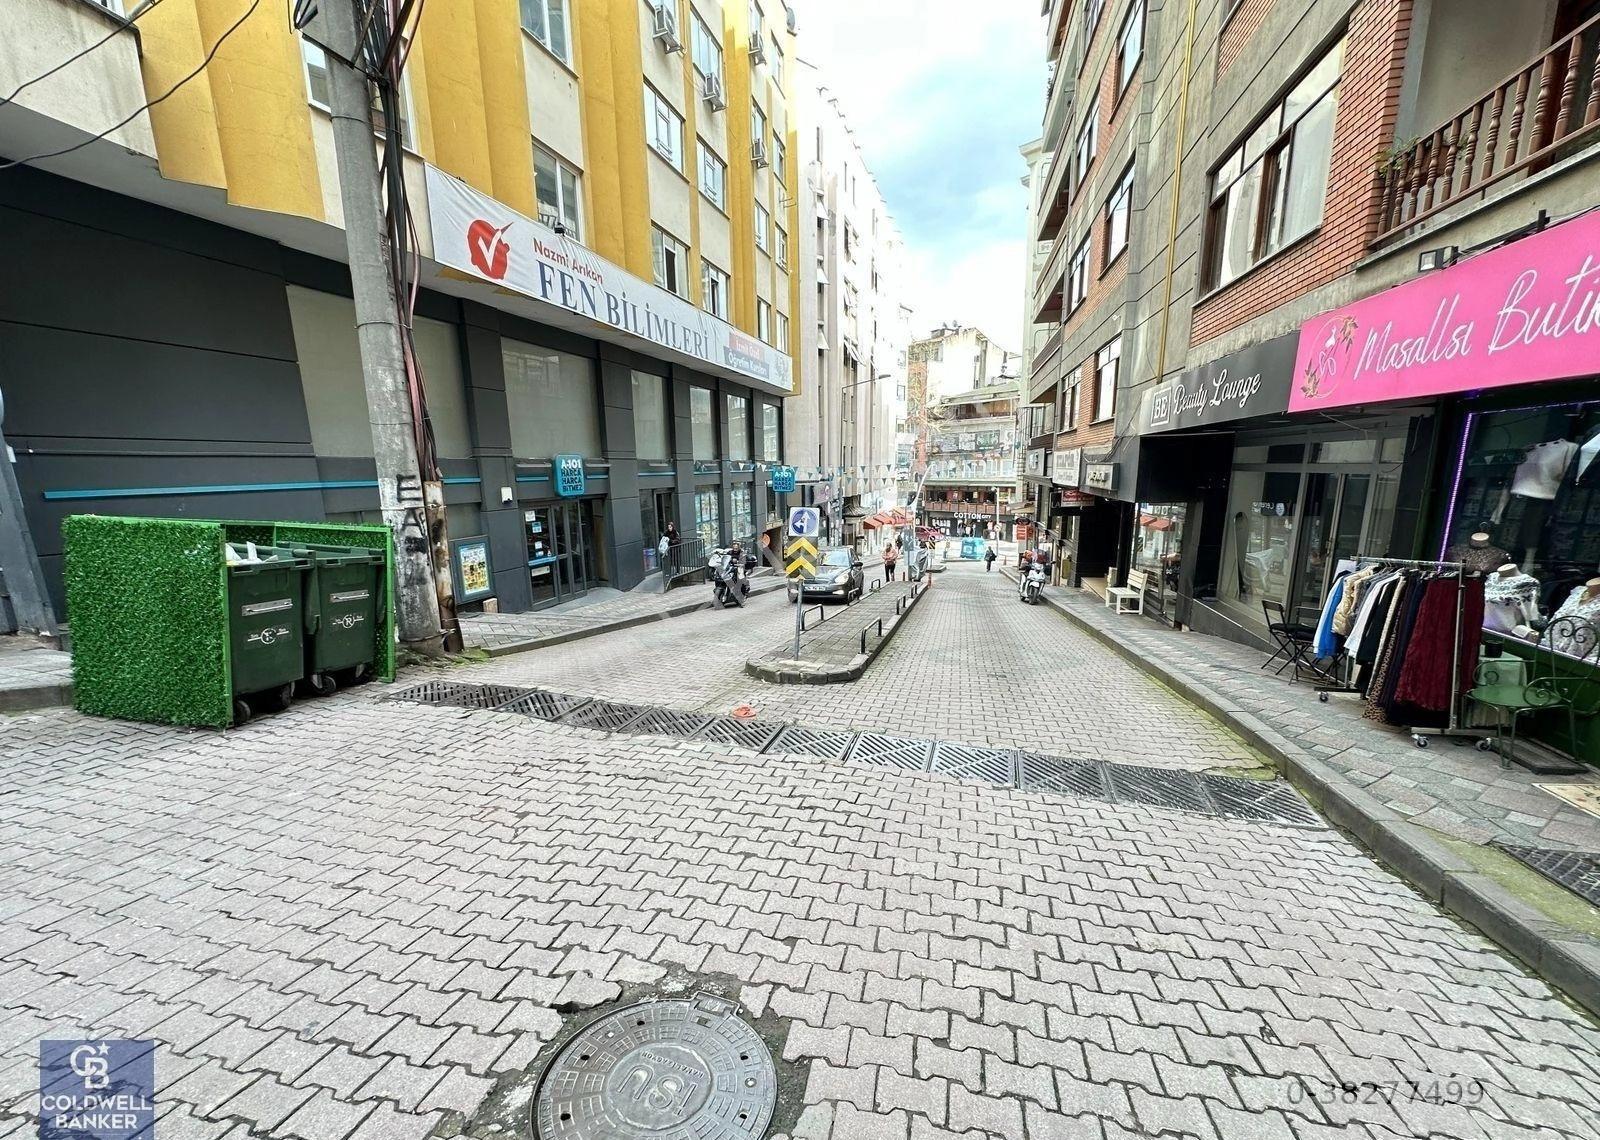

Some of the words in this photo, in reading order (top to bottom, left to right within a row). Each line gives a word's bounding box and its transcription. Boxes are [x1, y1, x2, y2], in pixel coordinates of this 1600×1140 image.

[533, 237, 569, 272] Nazmi
[571, 260, 603, 286] Arıkan
[536, 259, 598, 319] FEN
[604, 290, 709, 361] BİLİMLERİ
[1153, 395, 1168, 419] BE
[1173, 384, 1209, 417] Beauty
[1209, 368, 1262, 409] Lounge
[561, 468, 582, 477] HARCA
[562, 476, 582, 485] HARCA
